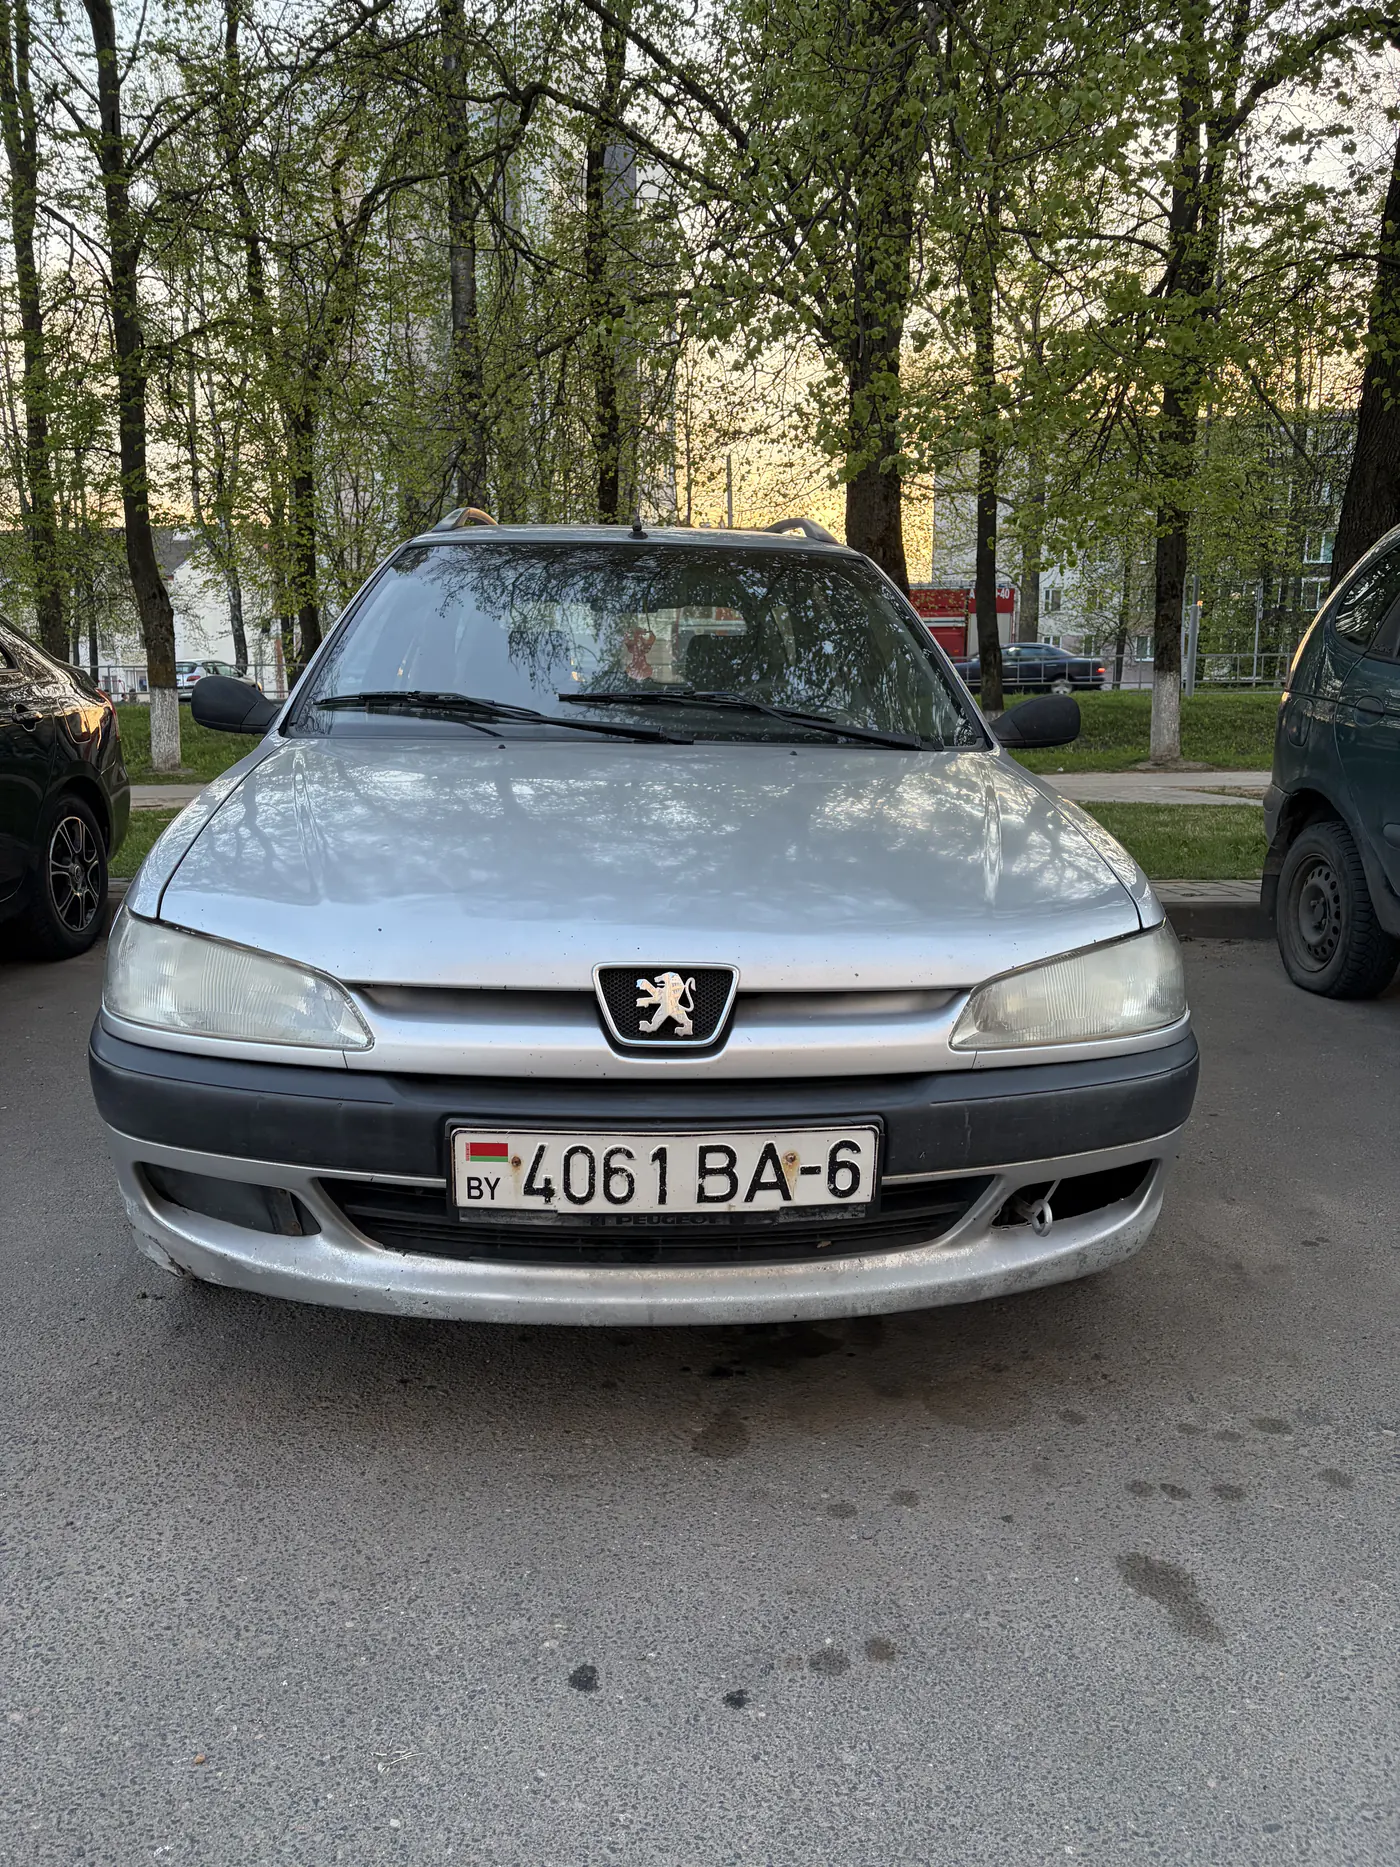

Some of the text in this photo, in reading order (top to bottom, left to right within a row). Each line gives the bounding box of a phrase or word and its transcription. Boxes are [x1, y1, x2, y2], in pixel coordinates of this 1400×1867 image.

[522, 1139, 862, 1205] 4061 BA-6
[466, 1176, 501, 1200] BY
[615, 1214, 721, 1225] PEUGEOT
